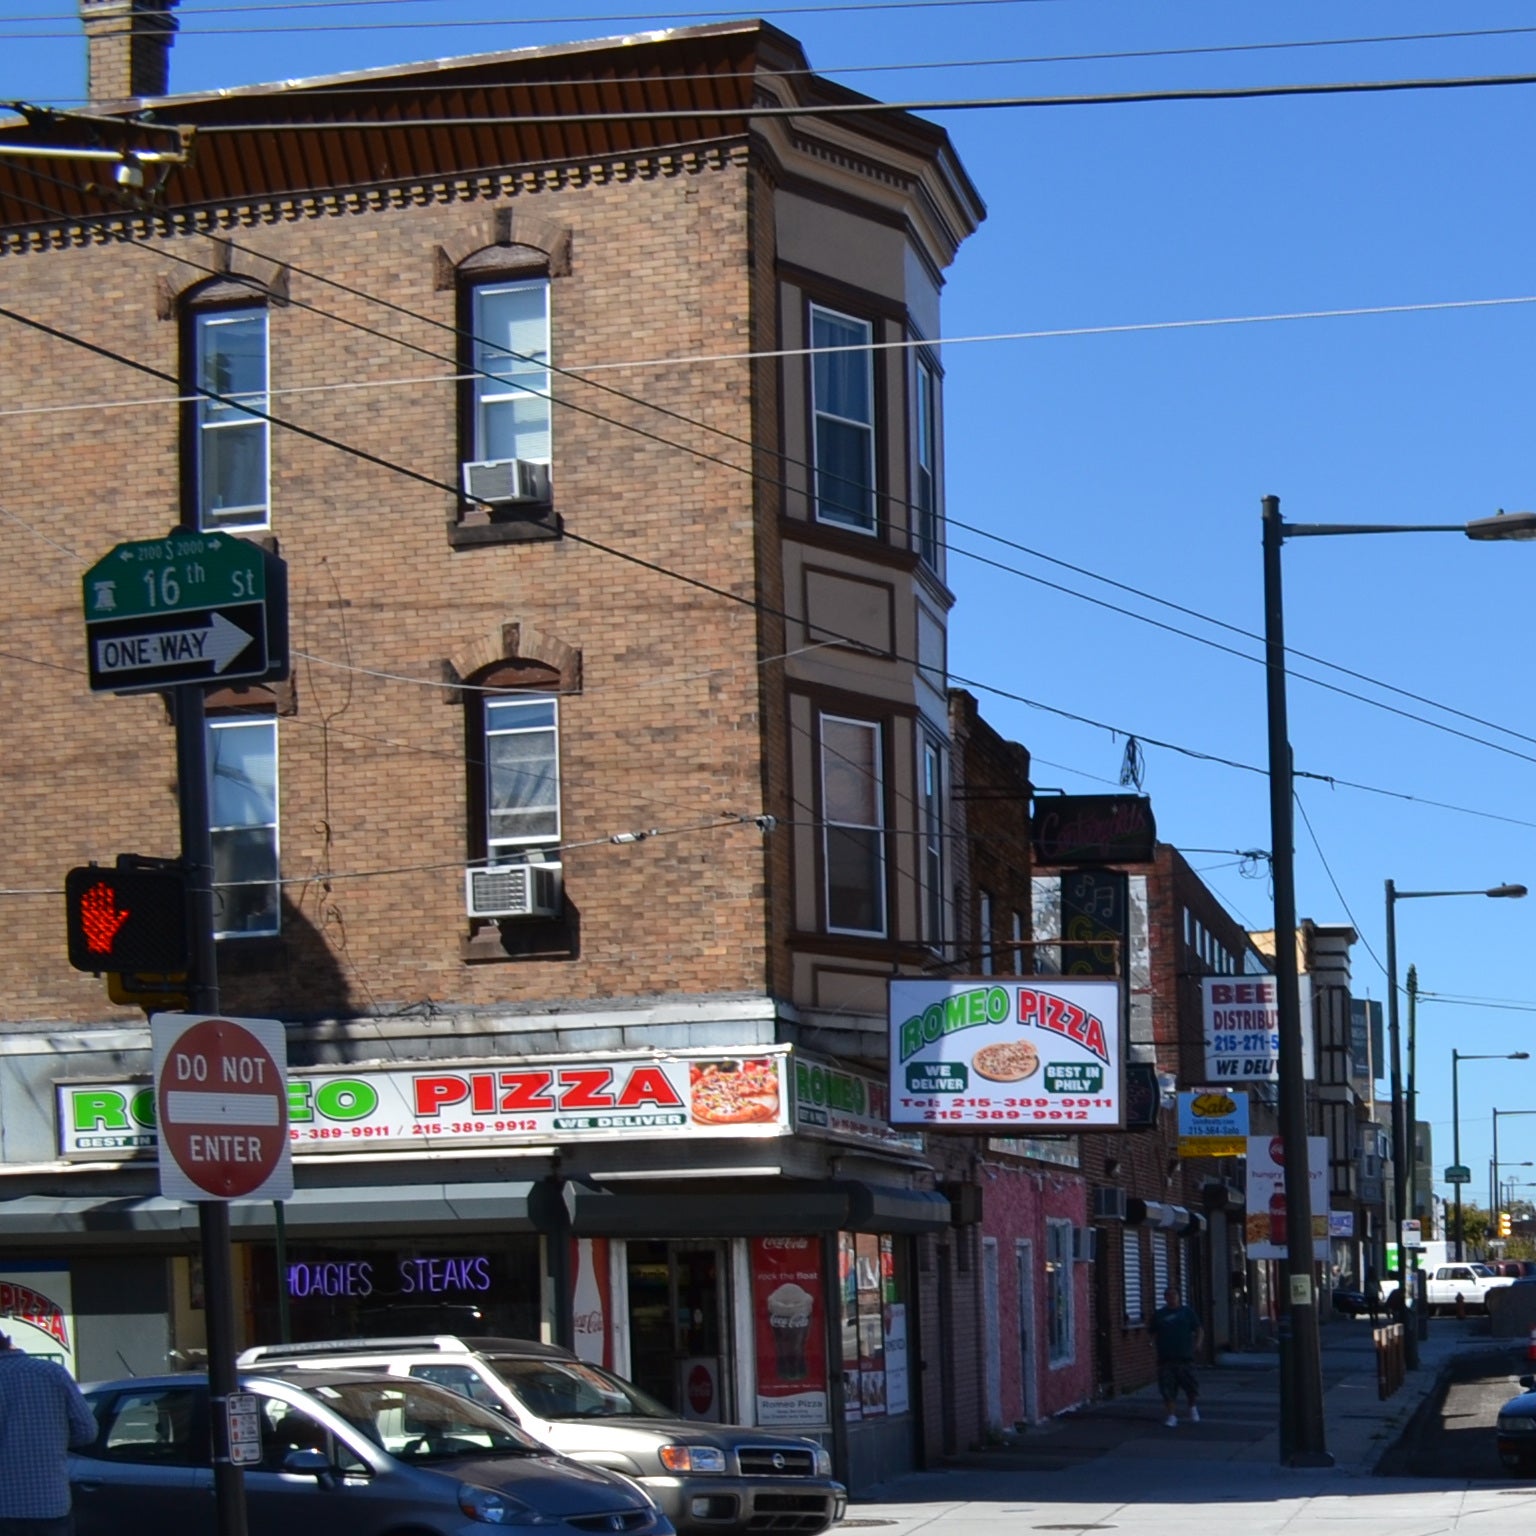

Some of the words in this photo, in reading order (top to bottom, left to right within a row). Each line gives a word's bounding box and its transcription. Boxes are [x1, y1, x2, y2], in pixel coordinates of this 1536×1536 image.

[143, 562, 205, 607] 16th
[232, 569, 255, 597] St
[104, 638, 151, 668] ONE
[159, 631, 208, 661] WAY
[1211, 984, 1274, 1004] BEE
[899, 986, 1010, 1065] ROMEO
[1017, 987, 1111, 1066] PIZZA
[1214, 1009, 1279, 1031] DISTRIBU
[1214, 1034, 1279, 1051] 215-271-5
[177, 1054, 207, 1081] DO
[223, 1057, 265, 1084] NOT
[924, 1065, 951, 1076] WE
[1047, 1067, 1081, 1078] BEST
[1086, 1067, 1099, 1078] IN
[1217, 1060, 1238, 1075] WE
[1243, 1058, 1275, 1074] DELI
[413, 1065, 685, 1117] PIZZA
[911, 1079, 964, 1090] DELIVER
[1054, 1080, 1091, 1091] PHILY
[900, 1098, 940, 1107] Tel:
[952, 1098, 1112, 1107] 215-389-9911
[558, 1117, 590, 1128] WE
[598, 1114, 683, 1127] DELIVER
[924, 1110, 1088, 1120] 215-389-9912
[290, 1126, 389, 1140] 5-389-9911
[412, 1119, 537, 1135] 215-389-9912
[79, 1137, 126, 1148] BEST
[133, 1136, 150, 1146] IN
[189, 1135, 262, 1162] ENTER
[763, 1237, 808, 1249] Coca-Cola
[400, 1257, 490, 1293] STEAKS
[779, 1272, 794, 1280] the
[762, 1400, 796, 1409] Romeo
[798, 1400, 823, 1409] Pizza
